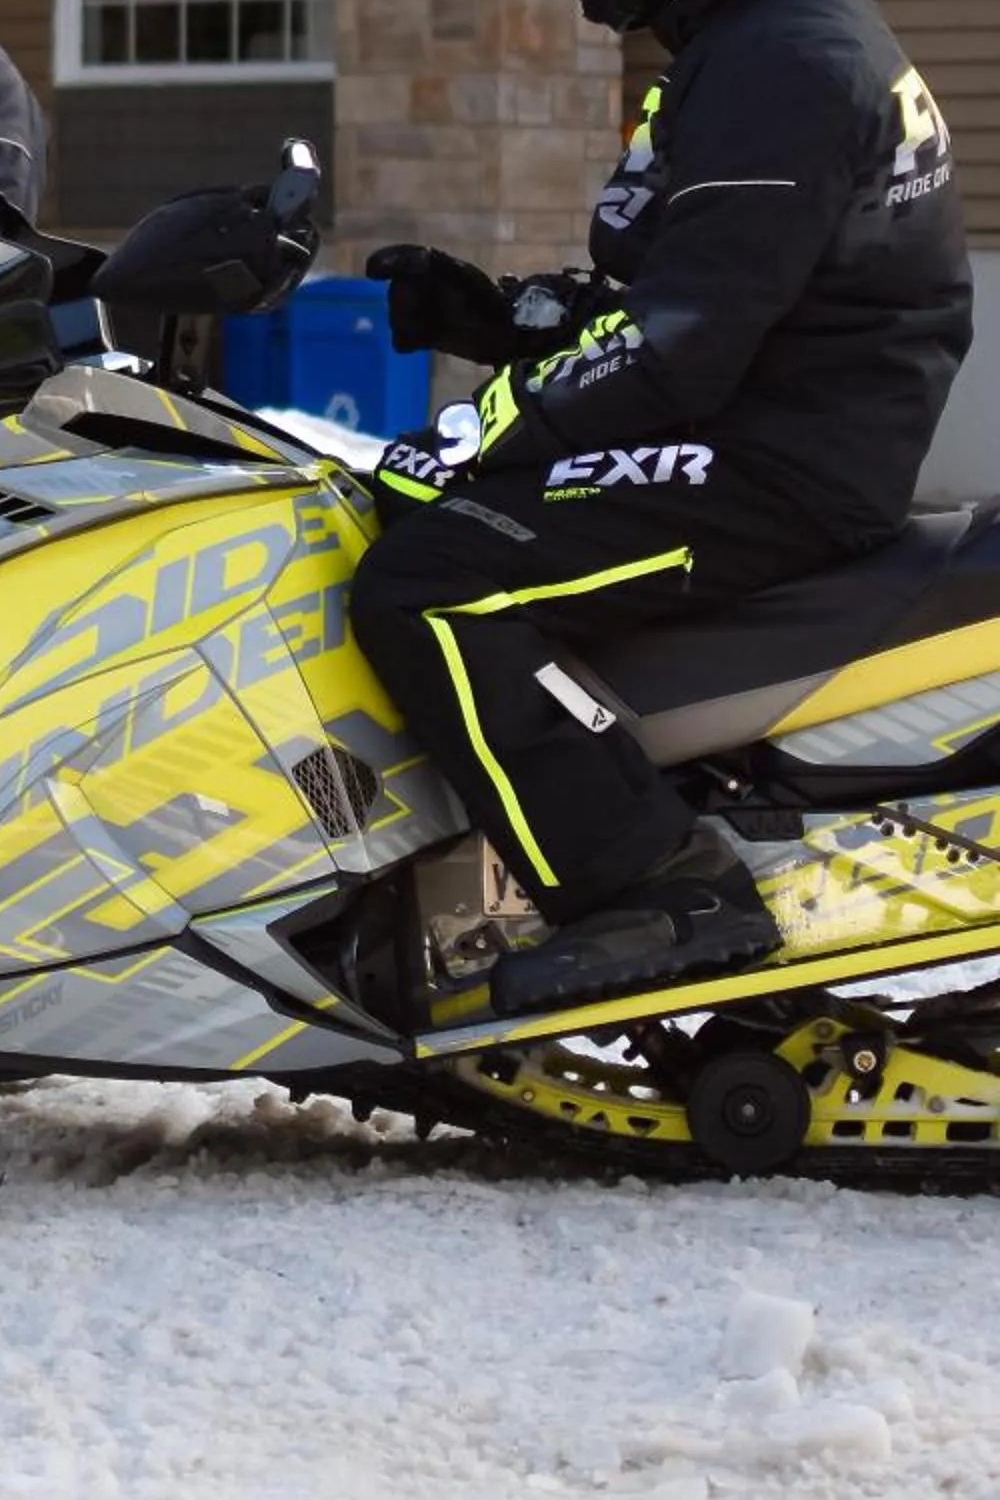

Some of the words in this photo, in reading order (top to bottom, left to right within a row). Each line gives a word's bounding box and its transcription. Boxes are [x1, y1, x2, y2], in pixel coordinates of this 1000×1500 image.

[885, 175, 933, 207] RIDE
[579, 354, 622, 390] RIDE
[545, 443, 715, 487] FXR
